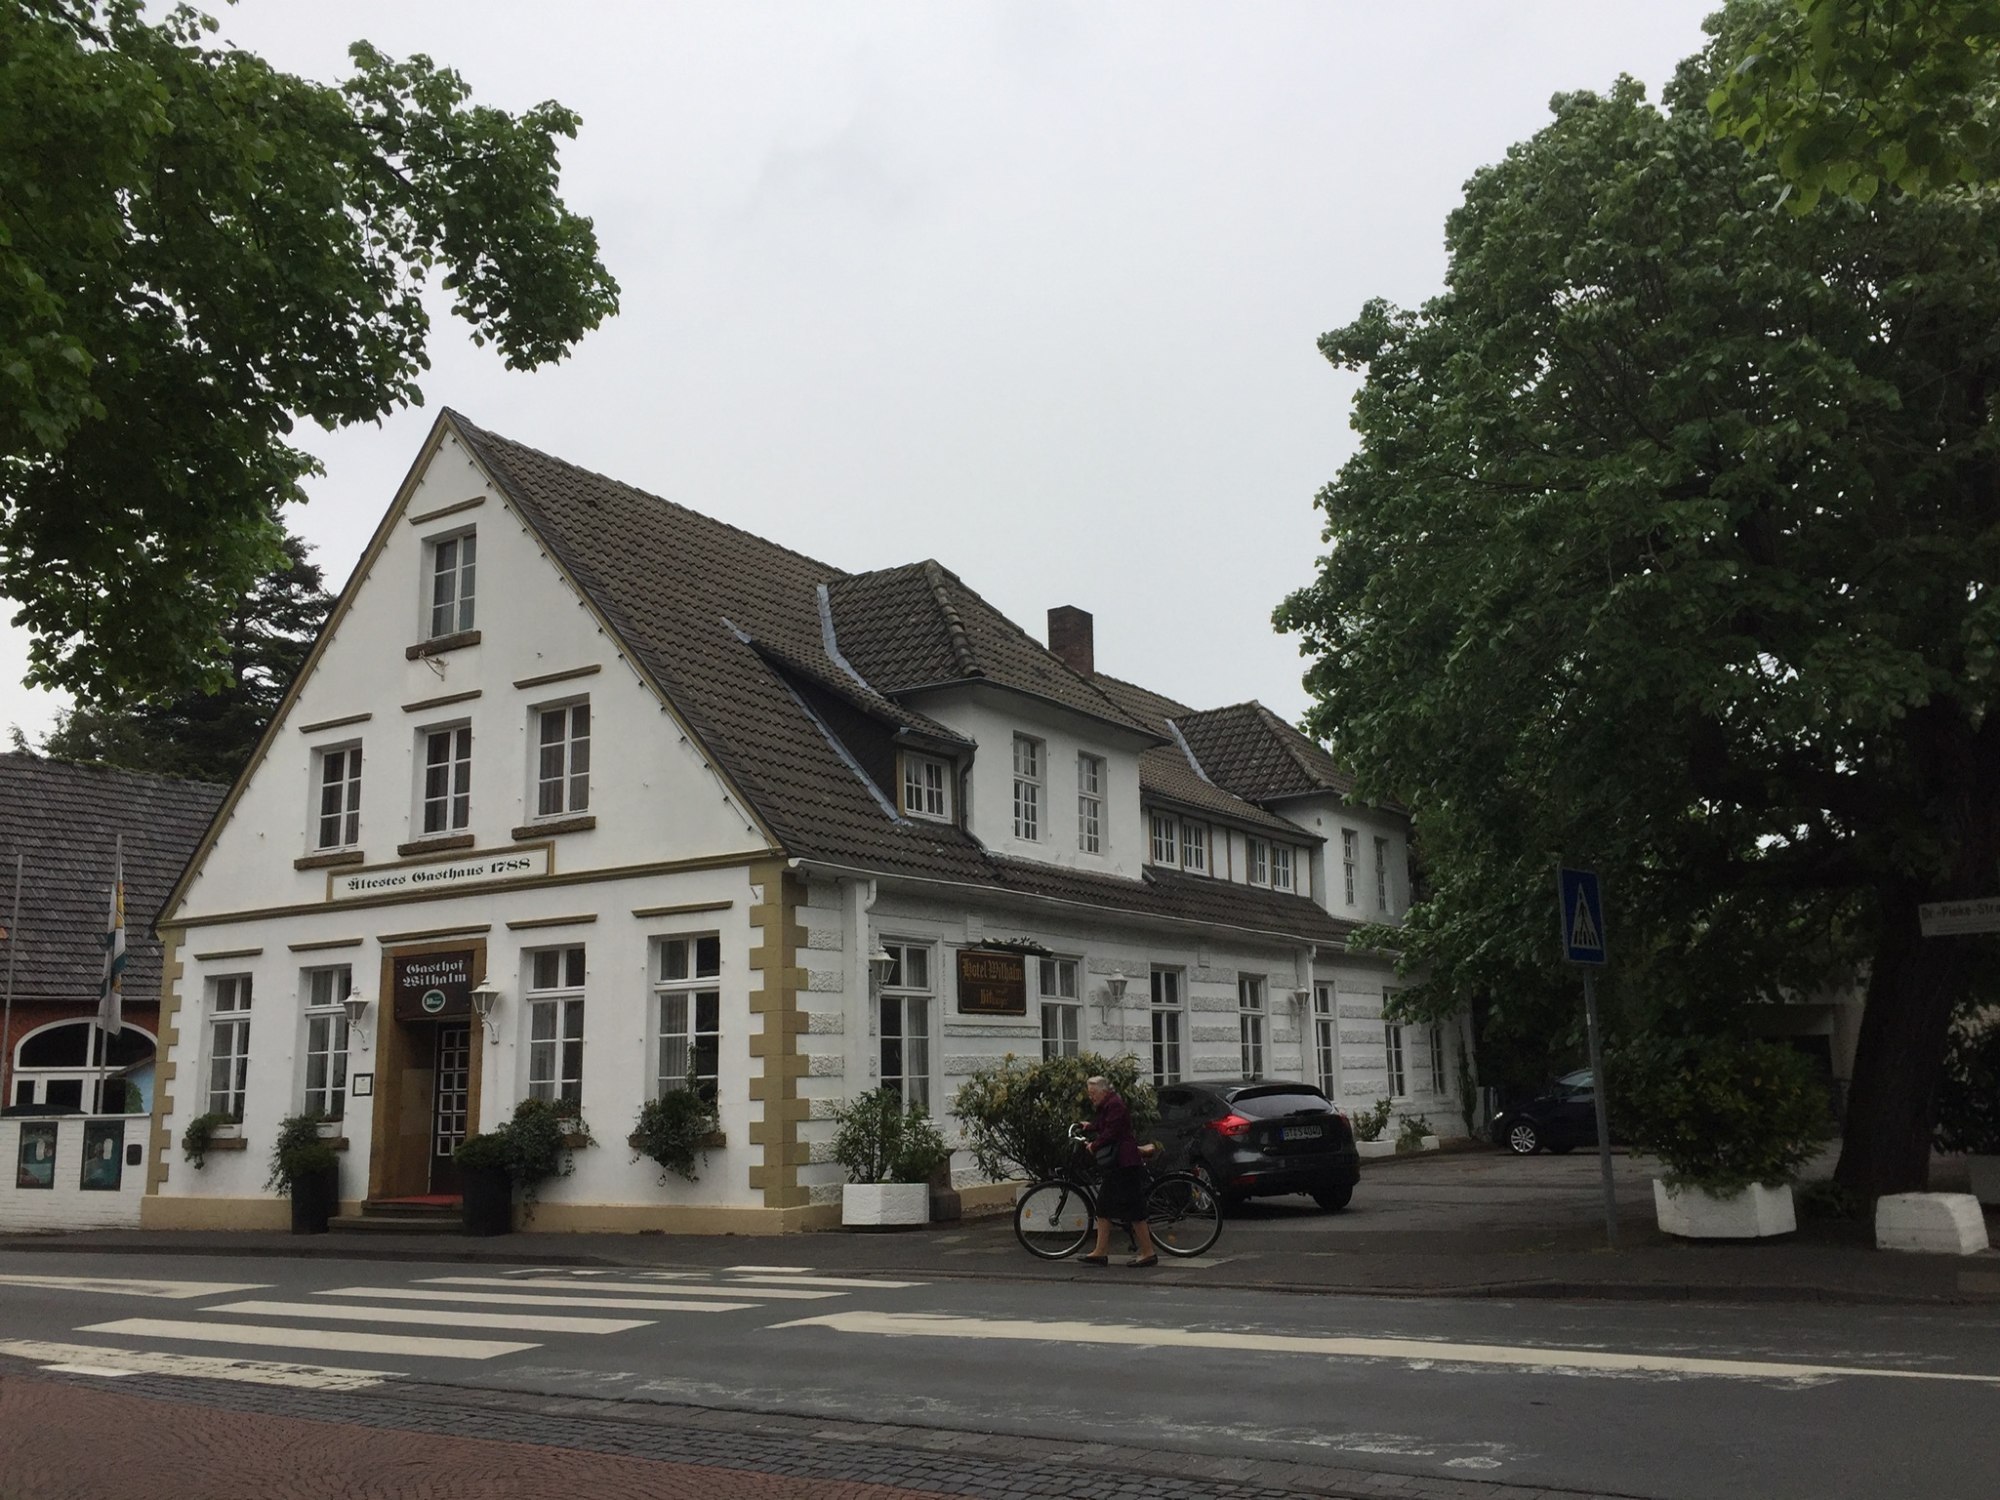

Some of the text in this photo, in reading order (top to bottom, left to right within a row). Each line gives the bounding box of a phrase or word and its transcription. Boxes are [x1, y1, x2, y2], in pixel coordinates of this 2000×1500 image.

[348, 858, 531, 890] Ältestes Gasthaus 1788
[406, 959, 464, 974] Gasthof
[961, 958, 1022, 984] Hotel Wilhalm
[402, 973, 467, 987] Wilhalm
